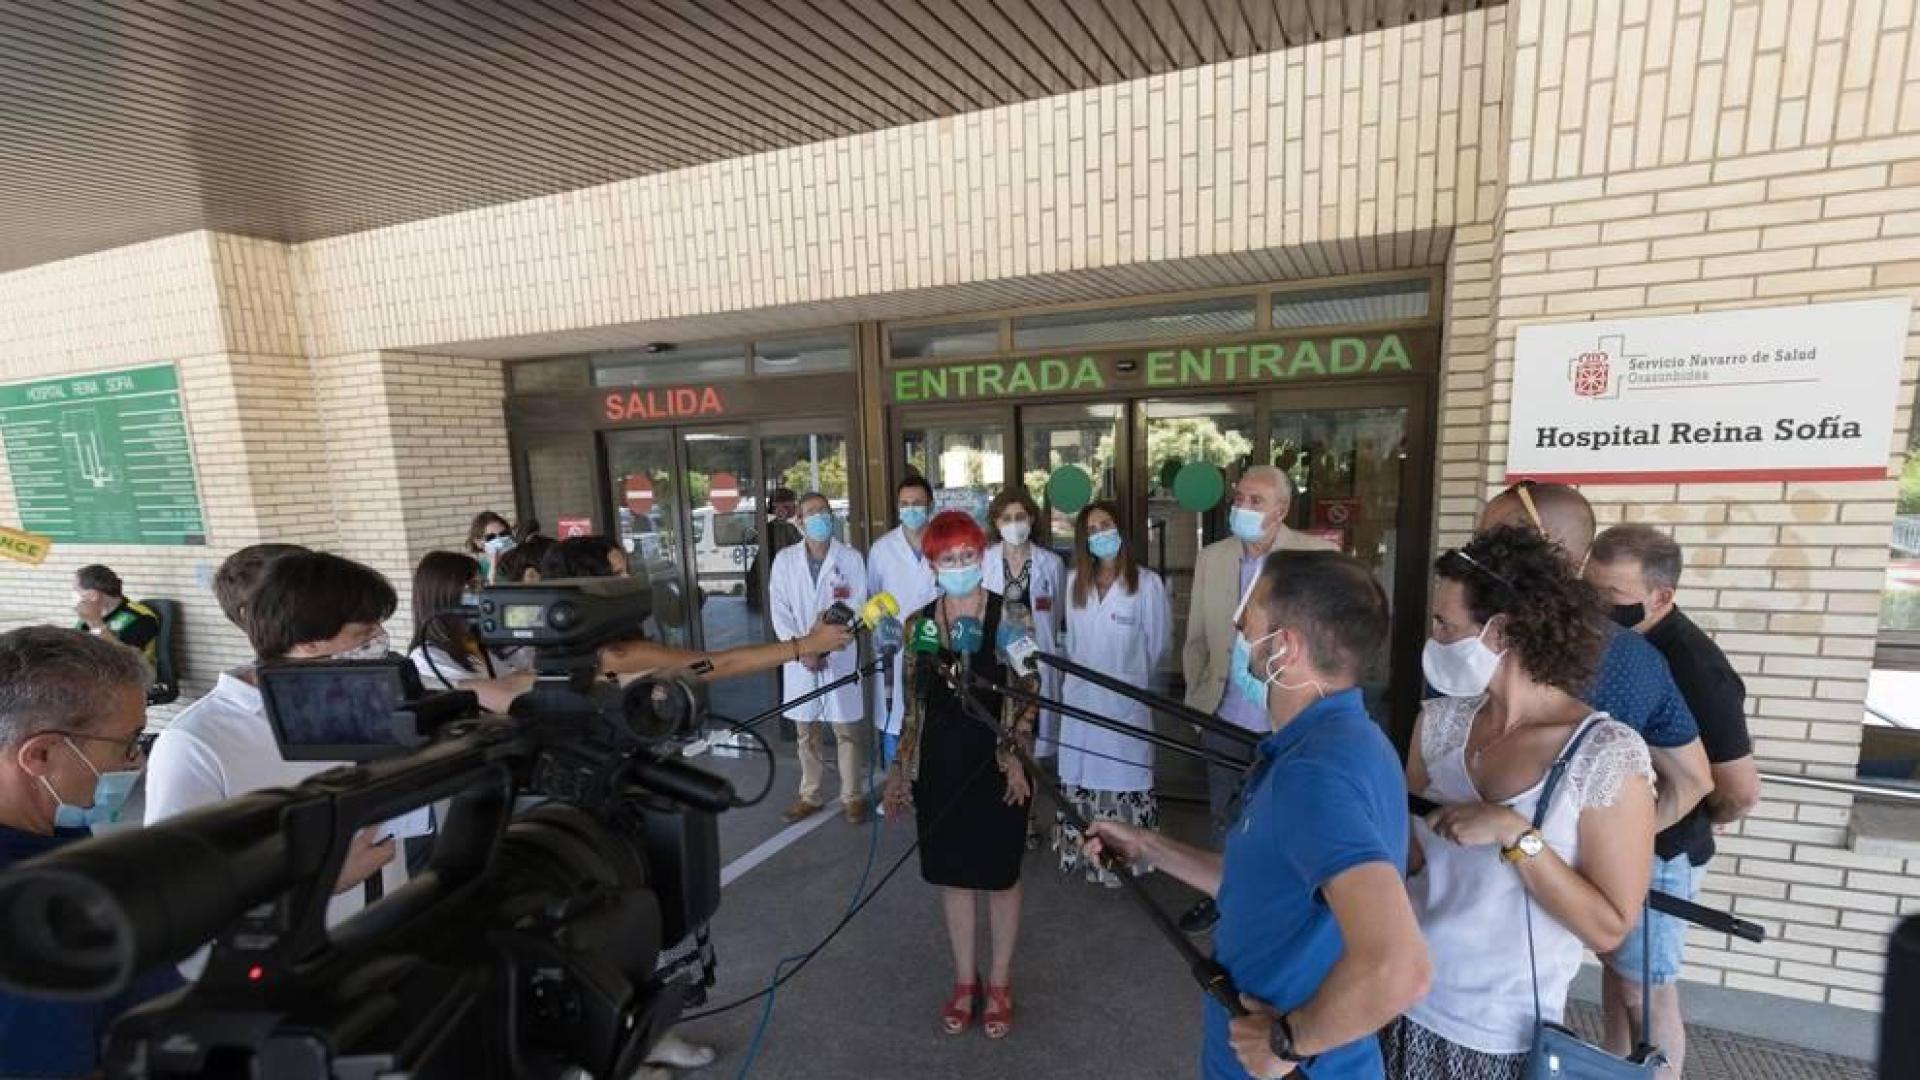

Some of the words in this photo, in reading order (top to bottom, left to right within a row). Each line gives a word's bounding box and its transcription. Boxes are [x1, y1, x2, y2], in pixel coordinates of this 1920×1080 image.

[895, 357, 1105, 401] ENTRADA
[1145, 335, 1413, 387] ENTRADA
[1629, 357, 1685, 371] Servicio
[1689, 353, 1747, 367] Navarro
[1752, 351, 1769, 363] de
[1775, 347, 1817, 361] Salud
[71, 379, 99, 396] REINA
[606, 386, 724, 421] SALIDA
[1536, 424, 1660, 451] Hospital
[1668, 421, 1762, 445] Reina
[1774, 415, 1862, 441] Sofía
